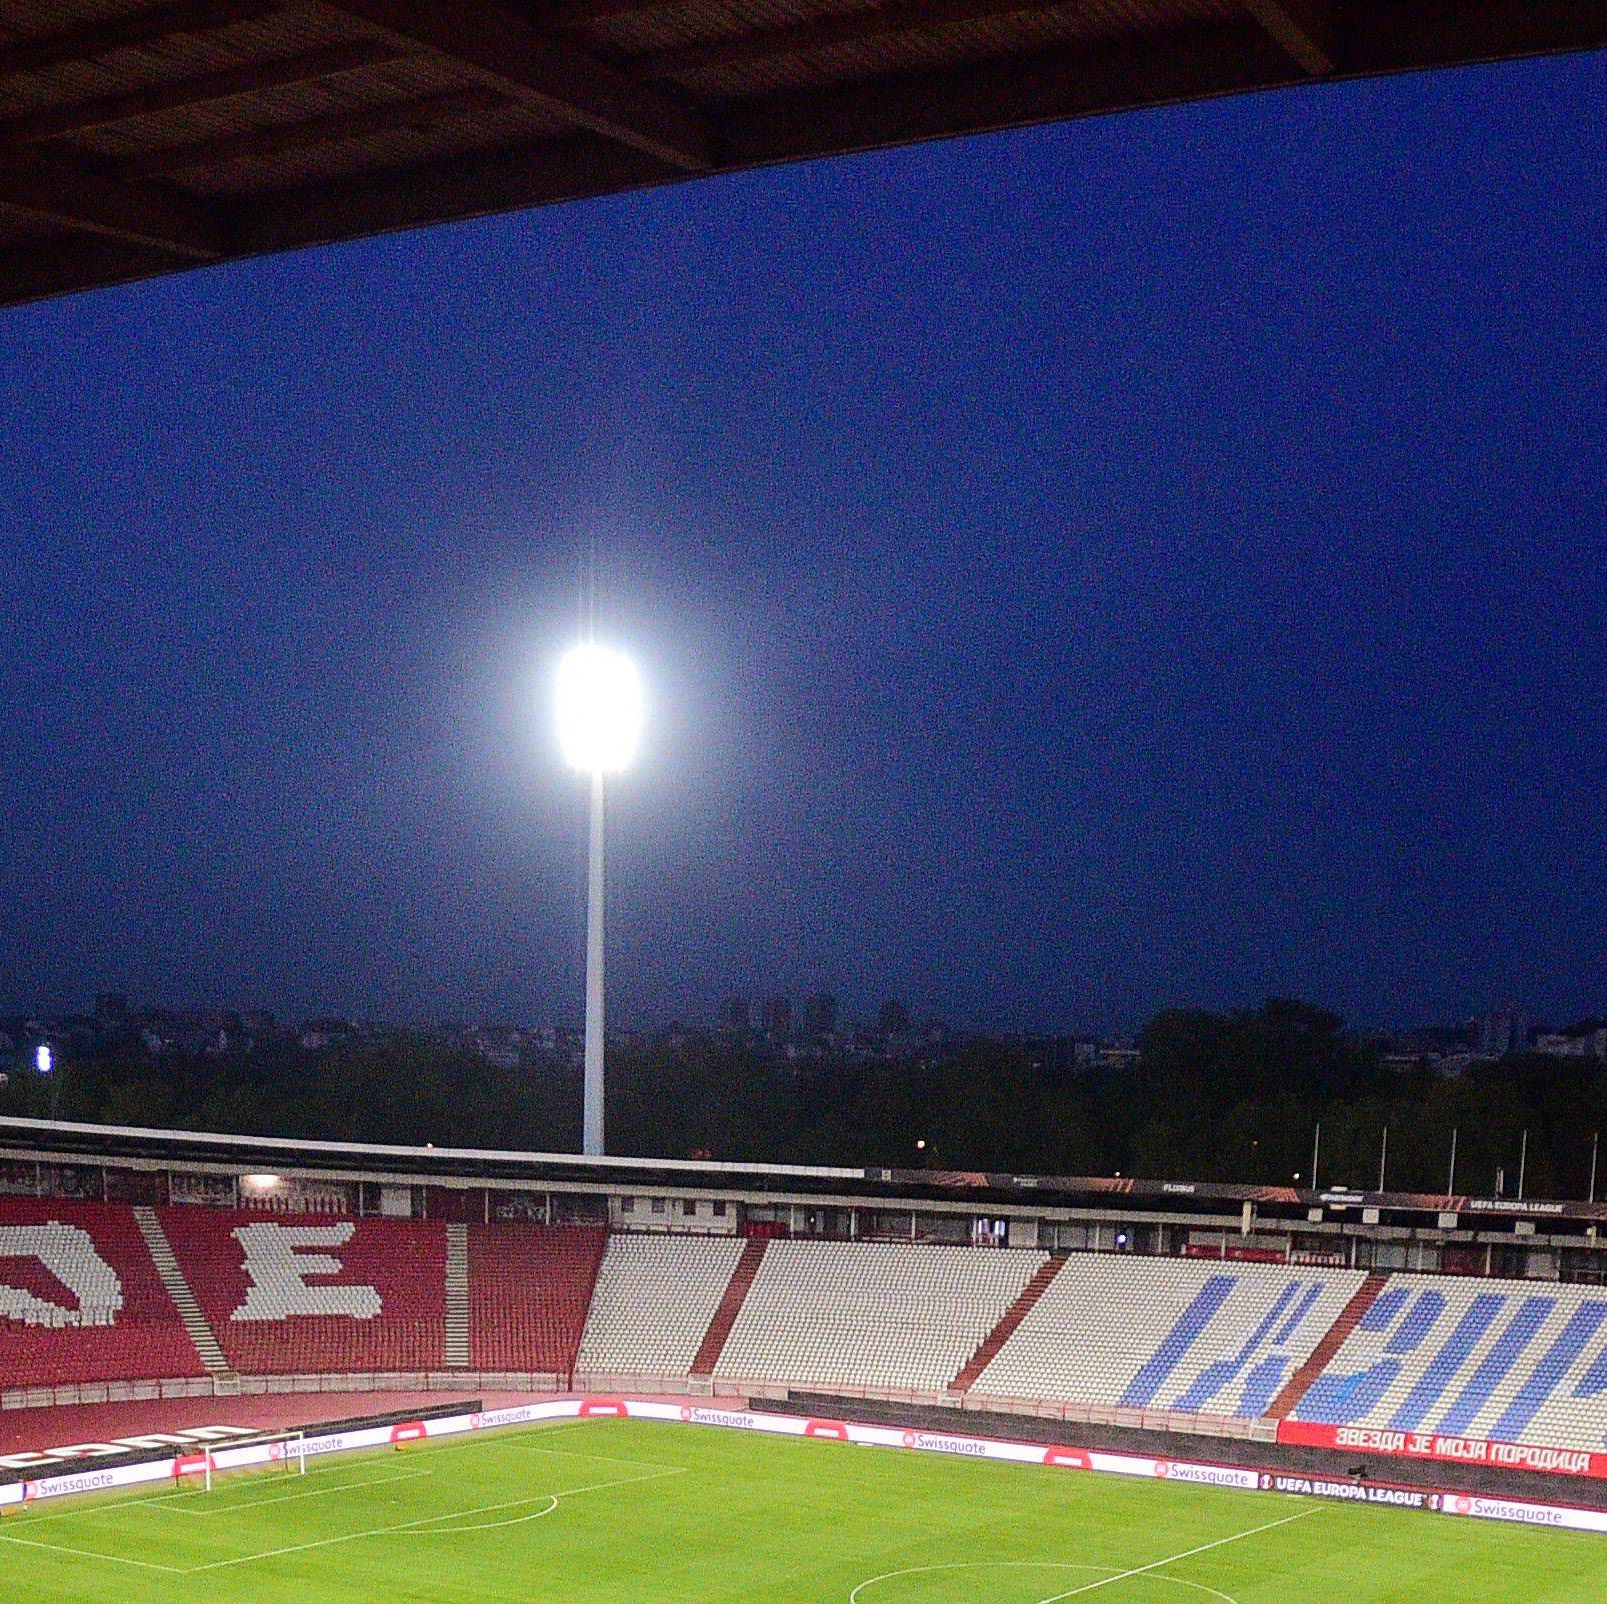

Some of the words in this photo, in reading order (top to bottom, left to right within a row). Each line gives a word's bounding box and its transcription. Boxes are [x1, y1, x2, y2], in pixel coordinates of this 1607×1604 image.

[1470, 1200, 1493, 1209] UEFA
[1494, 1201, 1528, 1211] EUROPA
[1529, 1203, 1562, 1213] LEAGUE
[481, 1409, 531, 1425] Swissquote
[693, 1408, 754, 1428] Swissquote
[917, 1435, 986, 1455] Swissquote
[1335, 1427, 1405, 1450] ЗВЕЗДА
[1490, 1444, 1591, 1472] ПОРОДИЦА
[40, 1472, 113, 1496] Swissquote
[1171, 1464, 1248, 1486] Swissquote
[1276, 1477, 1312, 1493] UEFA
[1313, 1482, 1366, 1500] EUROPA
[1369, 1489, 1423, 1507] LEAGUE
[1474, 1499, 1562, 1524] Swissquote
